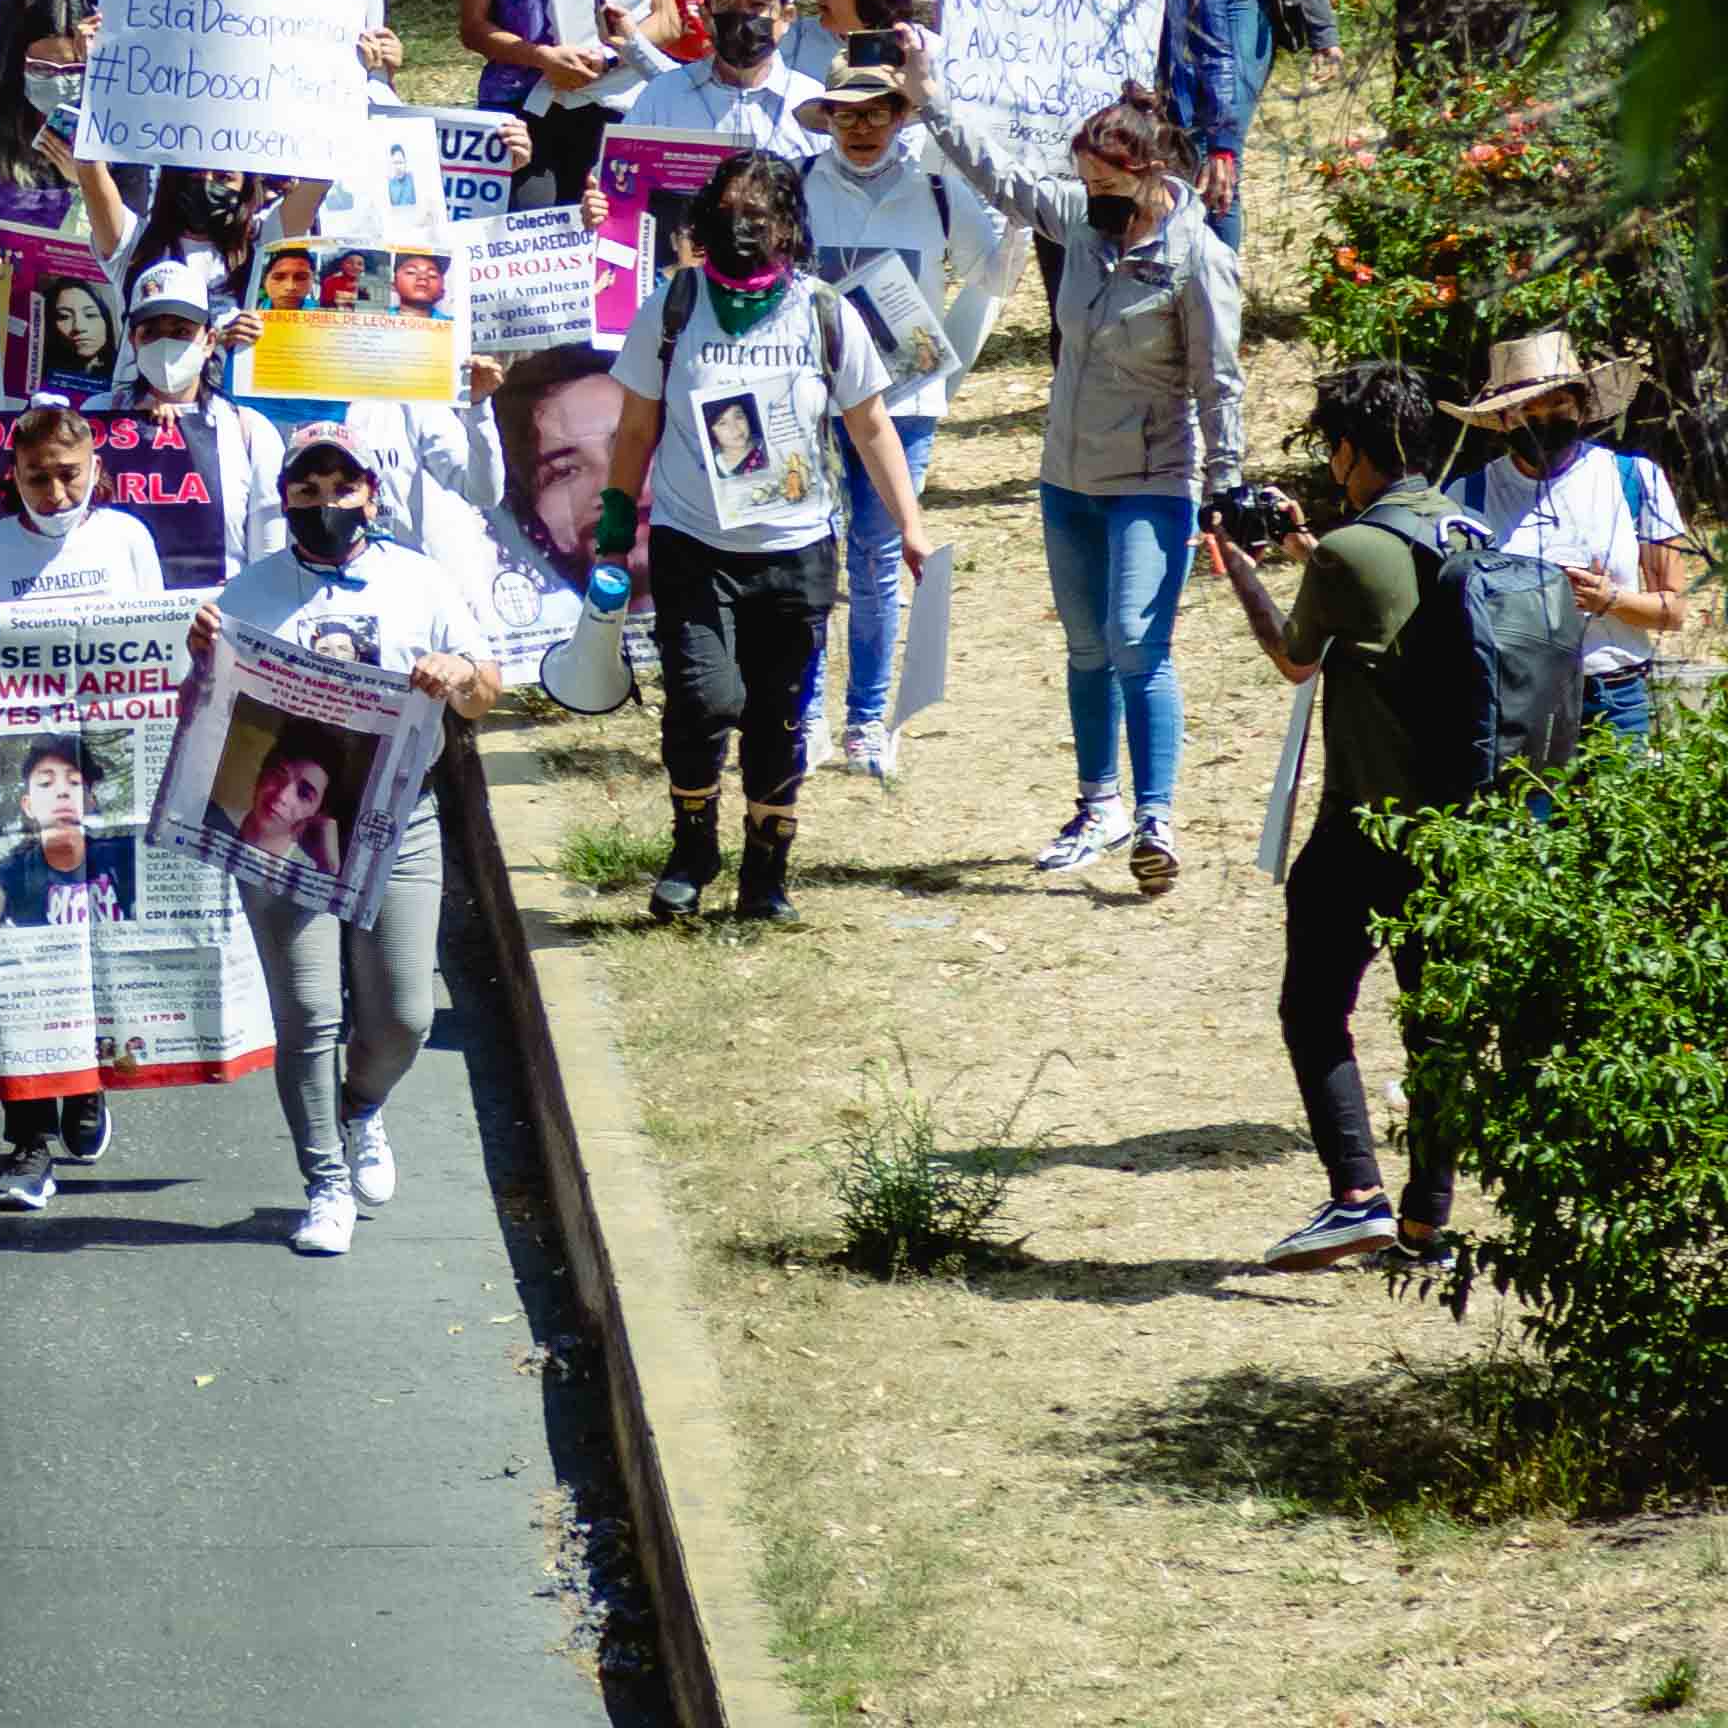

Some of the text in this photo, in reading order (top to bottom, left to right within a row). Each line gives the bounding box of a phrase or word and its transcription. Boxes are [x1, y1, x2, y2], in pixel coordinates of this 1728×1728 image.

[85, 109, 203, 151] No son
[506, 210, 571, 232] Colectivo
[507, 257, 583, 280] ROJAS
[493, 303, 577, 326] septiembre
[92, 610, 192, 627] Desaparecidos
[0, 639, 174, 670] SE BUSCA:
[75, 667, 179, 696] ARIEL
